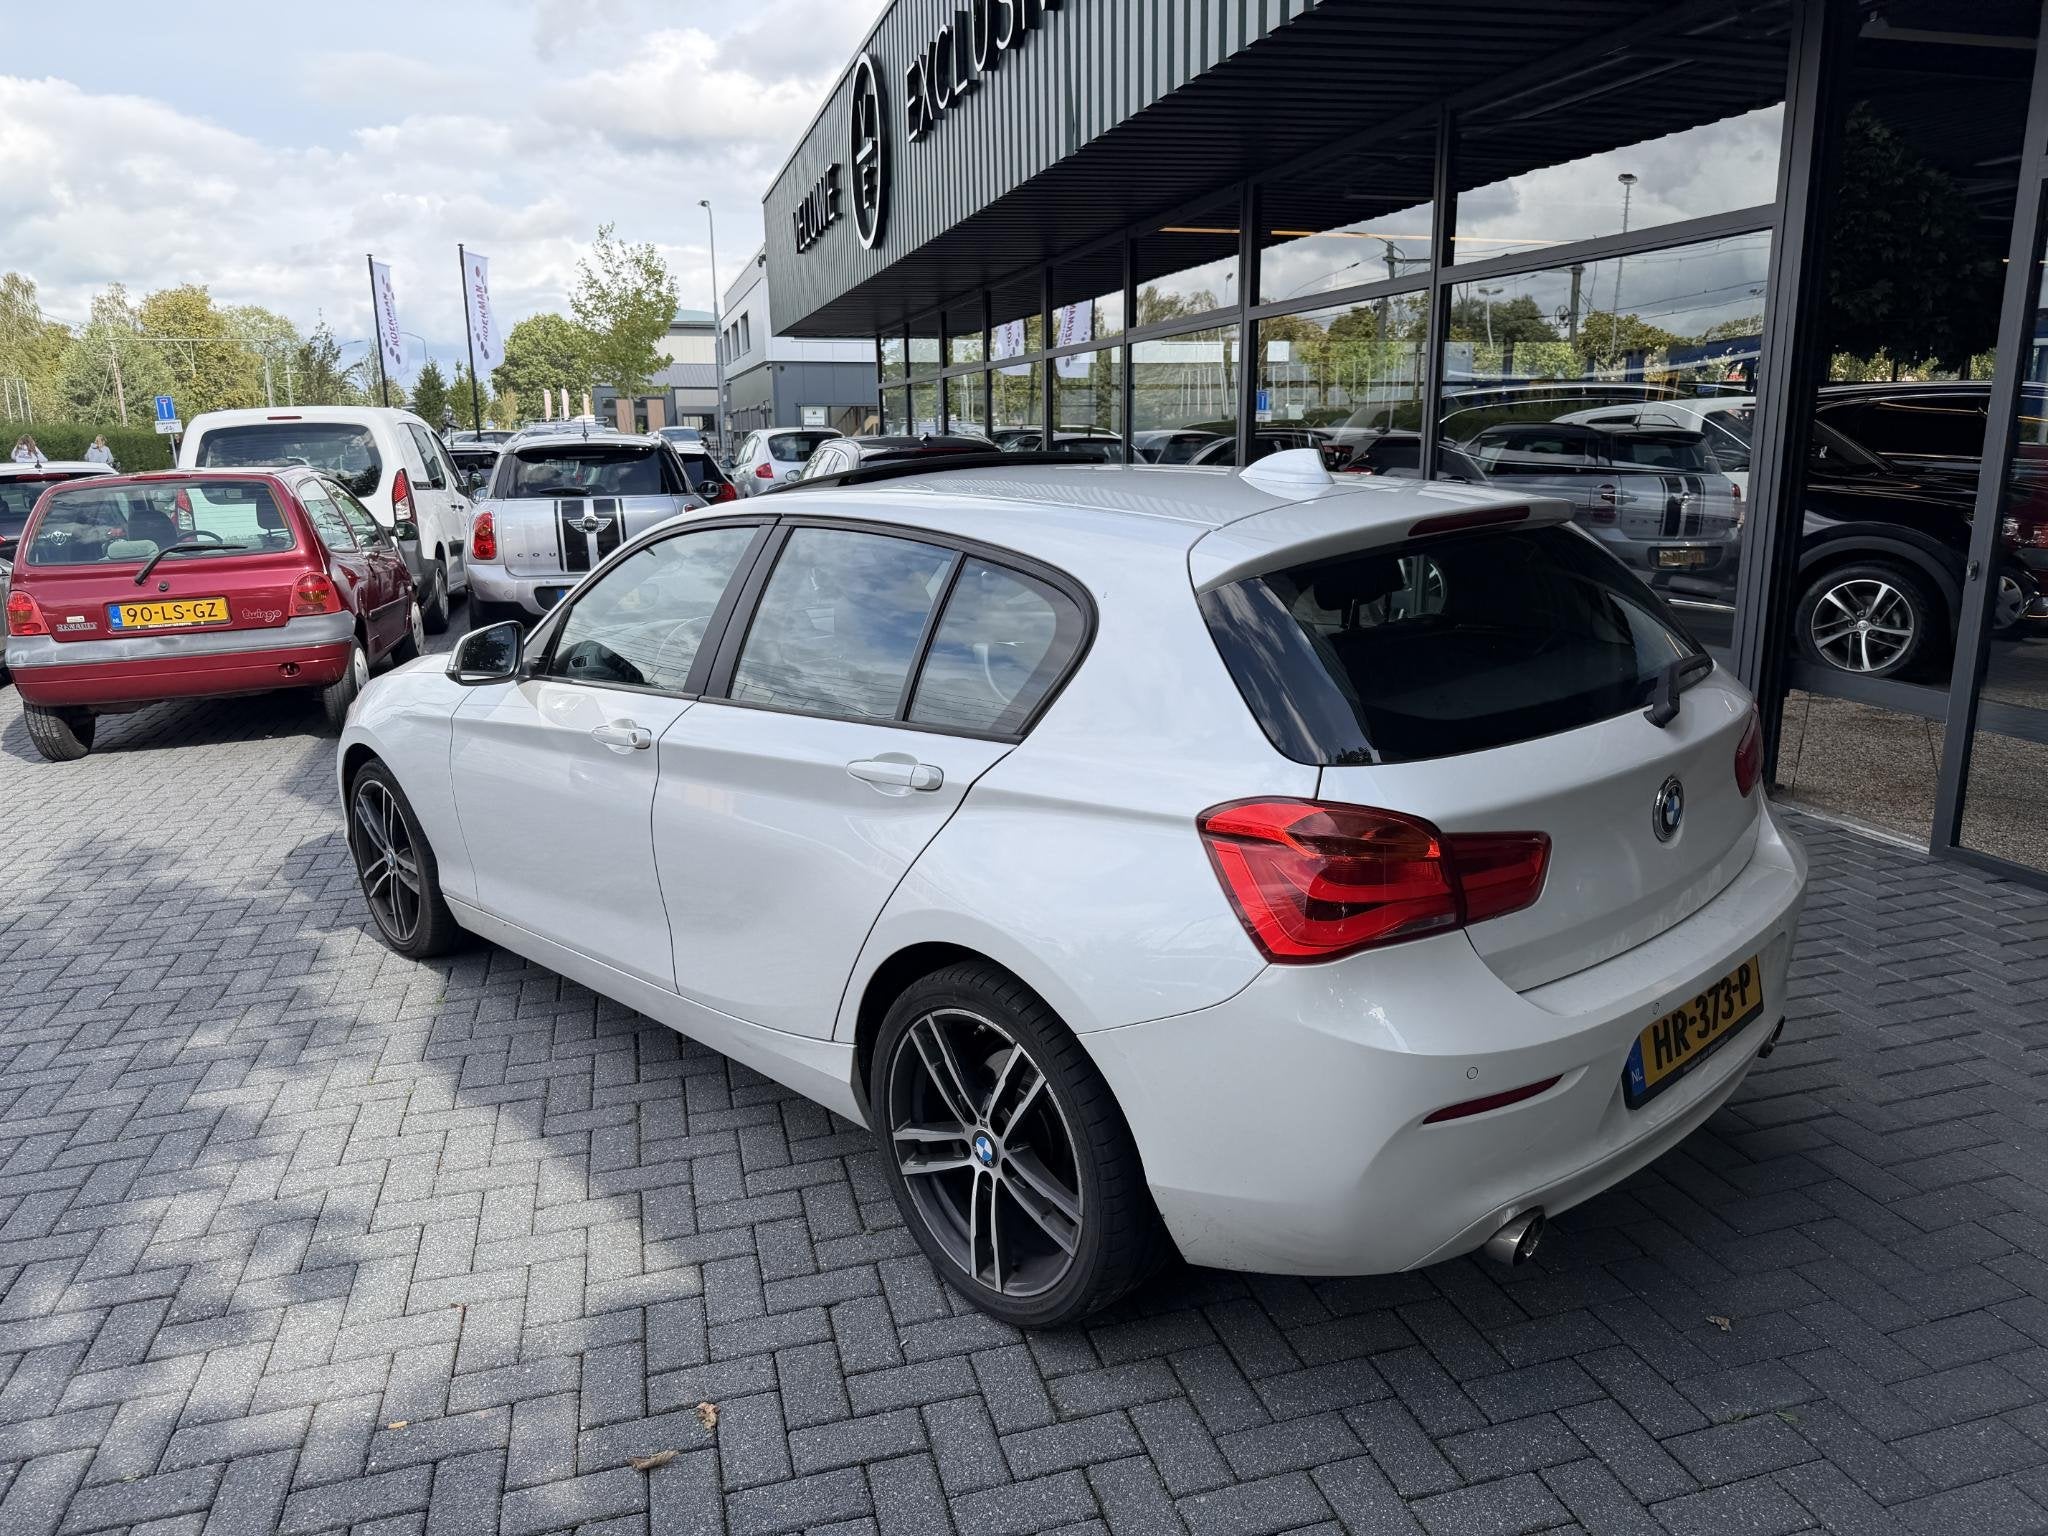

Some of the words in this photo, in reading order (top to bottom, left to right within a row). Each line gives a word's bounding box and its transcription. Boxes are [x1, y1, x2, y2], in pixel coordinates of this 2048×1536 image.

[906, 0, 1049, 142] EXCLUS
[126, 602, 218, 623] 90-LS-GZ
[1631, 1067, 1644, 1086] NL
[1652, 963, 1751, 1071] HR-373-P
